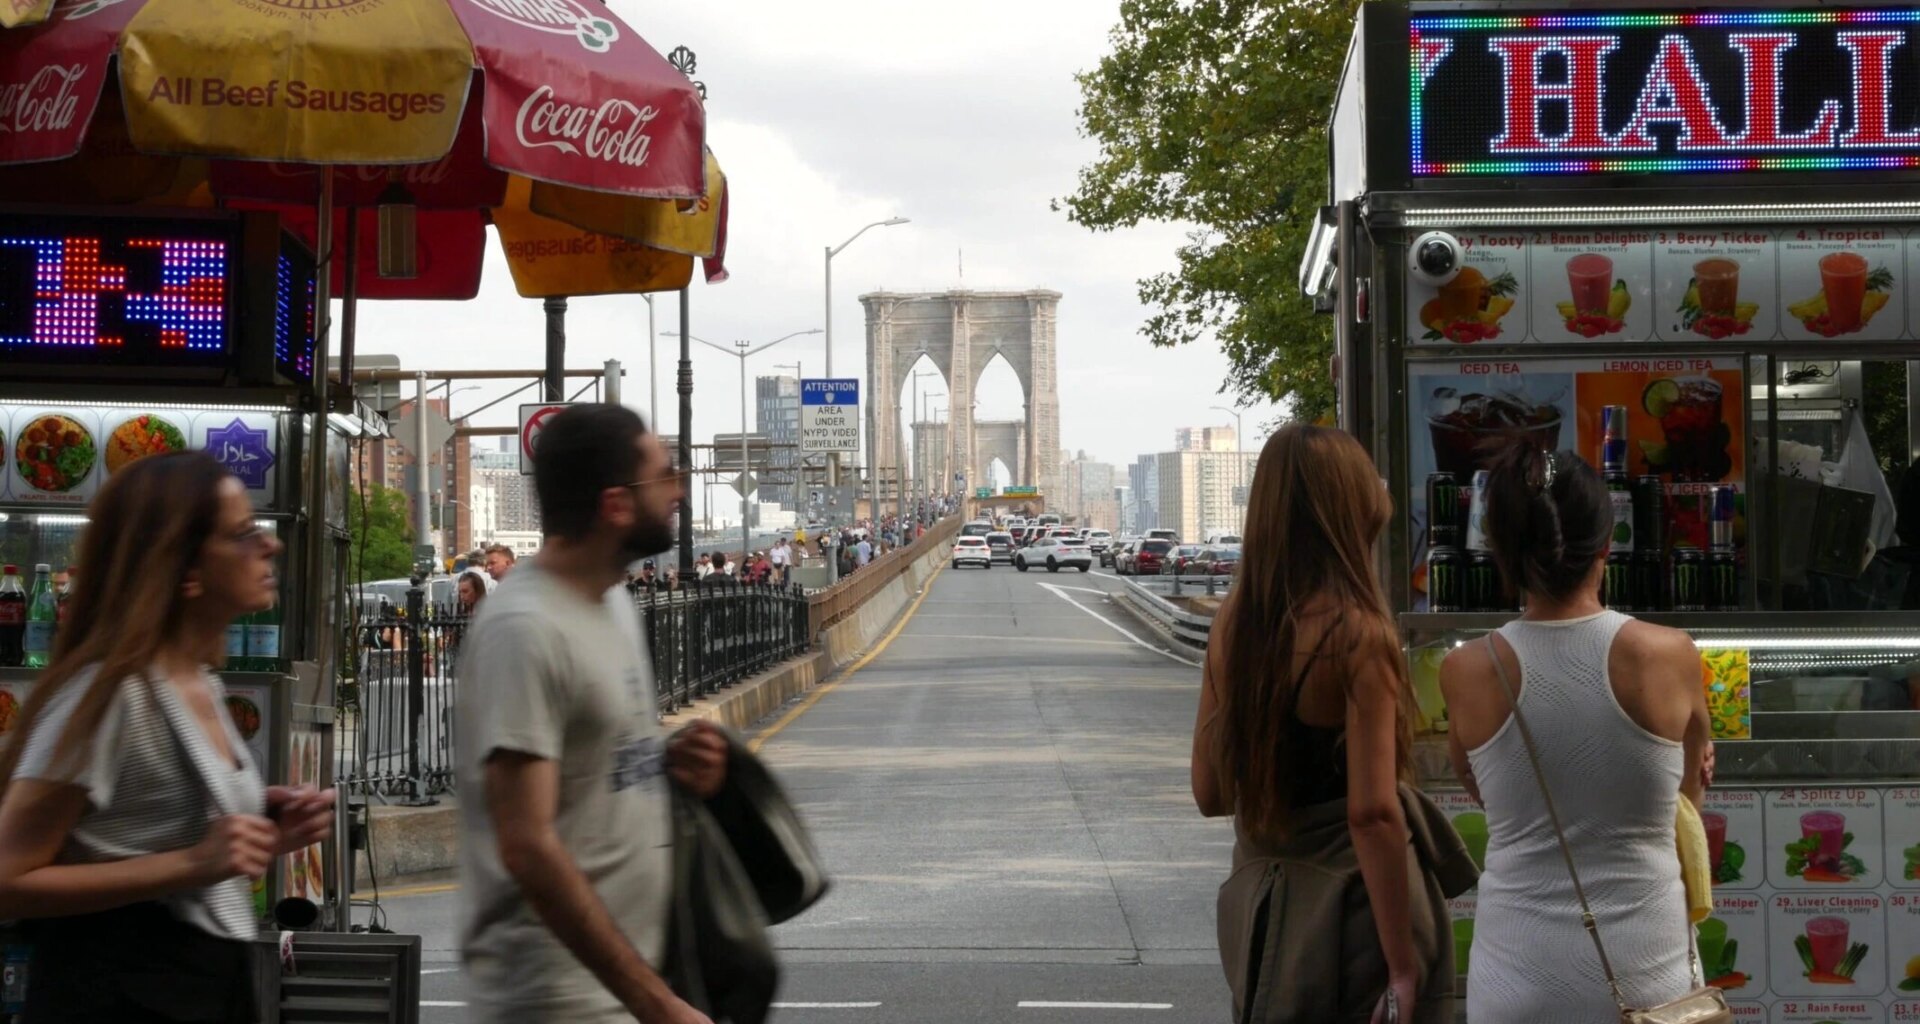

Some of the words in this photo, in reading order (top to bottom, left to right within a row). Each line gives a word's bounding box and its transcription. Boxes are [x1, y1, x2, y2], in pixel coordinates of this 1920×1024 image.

[149, 76, 192, 105] All
[201, 78, 279, 107] Beef
[285, 81, 447, 122] Sausages
[515, 85, 661, 167] Coca-Cola
[1534, 232, 1547, 245] 2.
[1551, 231, 1590, 245] Banan
[1595, 230, 1649, 247] Delights
[1659, 232, 1673, 245] 3.
[1677, 232, 1717, 248] Berry
[1722, 231, 1768, 244] Ticker
[1796, 229, 1813, 241] 4.
[1817, 227, 1885, 243] Tropical
[1479, 234, 1524, 249] Tooty
[1586, 245, 1628, 253] Strawberry
[1460, 363, 1490, 375] ICED
[1494, 362, 1520, 374] TEA
[1603, 360, 1649, 372] LEMON
[1653, 360, 1683, 371] ICED
[1688, 359, 1713, 370] TEA
[804, 382, 856, 391] ATTENTION
[818, 406, 843, 414] AREA
[804, 428, 828, 437] NYPD
[832, 428, 857, 437] VIDEO
[804, 439, 856, 448] SURVEILLANCE
[228, 464, 252, 475] ALAL
[1679, 483, 1709, 495] ICED
[1451, 794, 1476, 804] Heal
[1722, 790, 1754, 801] Boost
[1801, 788, 1842, 803] Splitz
[1846, 788, 1866, 803] Up
[1723, 898, 1759, 909] Helper
[1776, 897, 1794, 907] 29.
[1797, 896, 1826, 906] Liver
[1828, 896, 1879, 908] Cleaning
[1808, 1002, 1831, 1013] Rain
[1833, 1002, 1866, 1013] Forest
